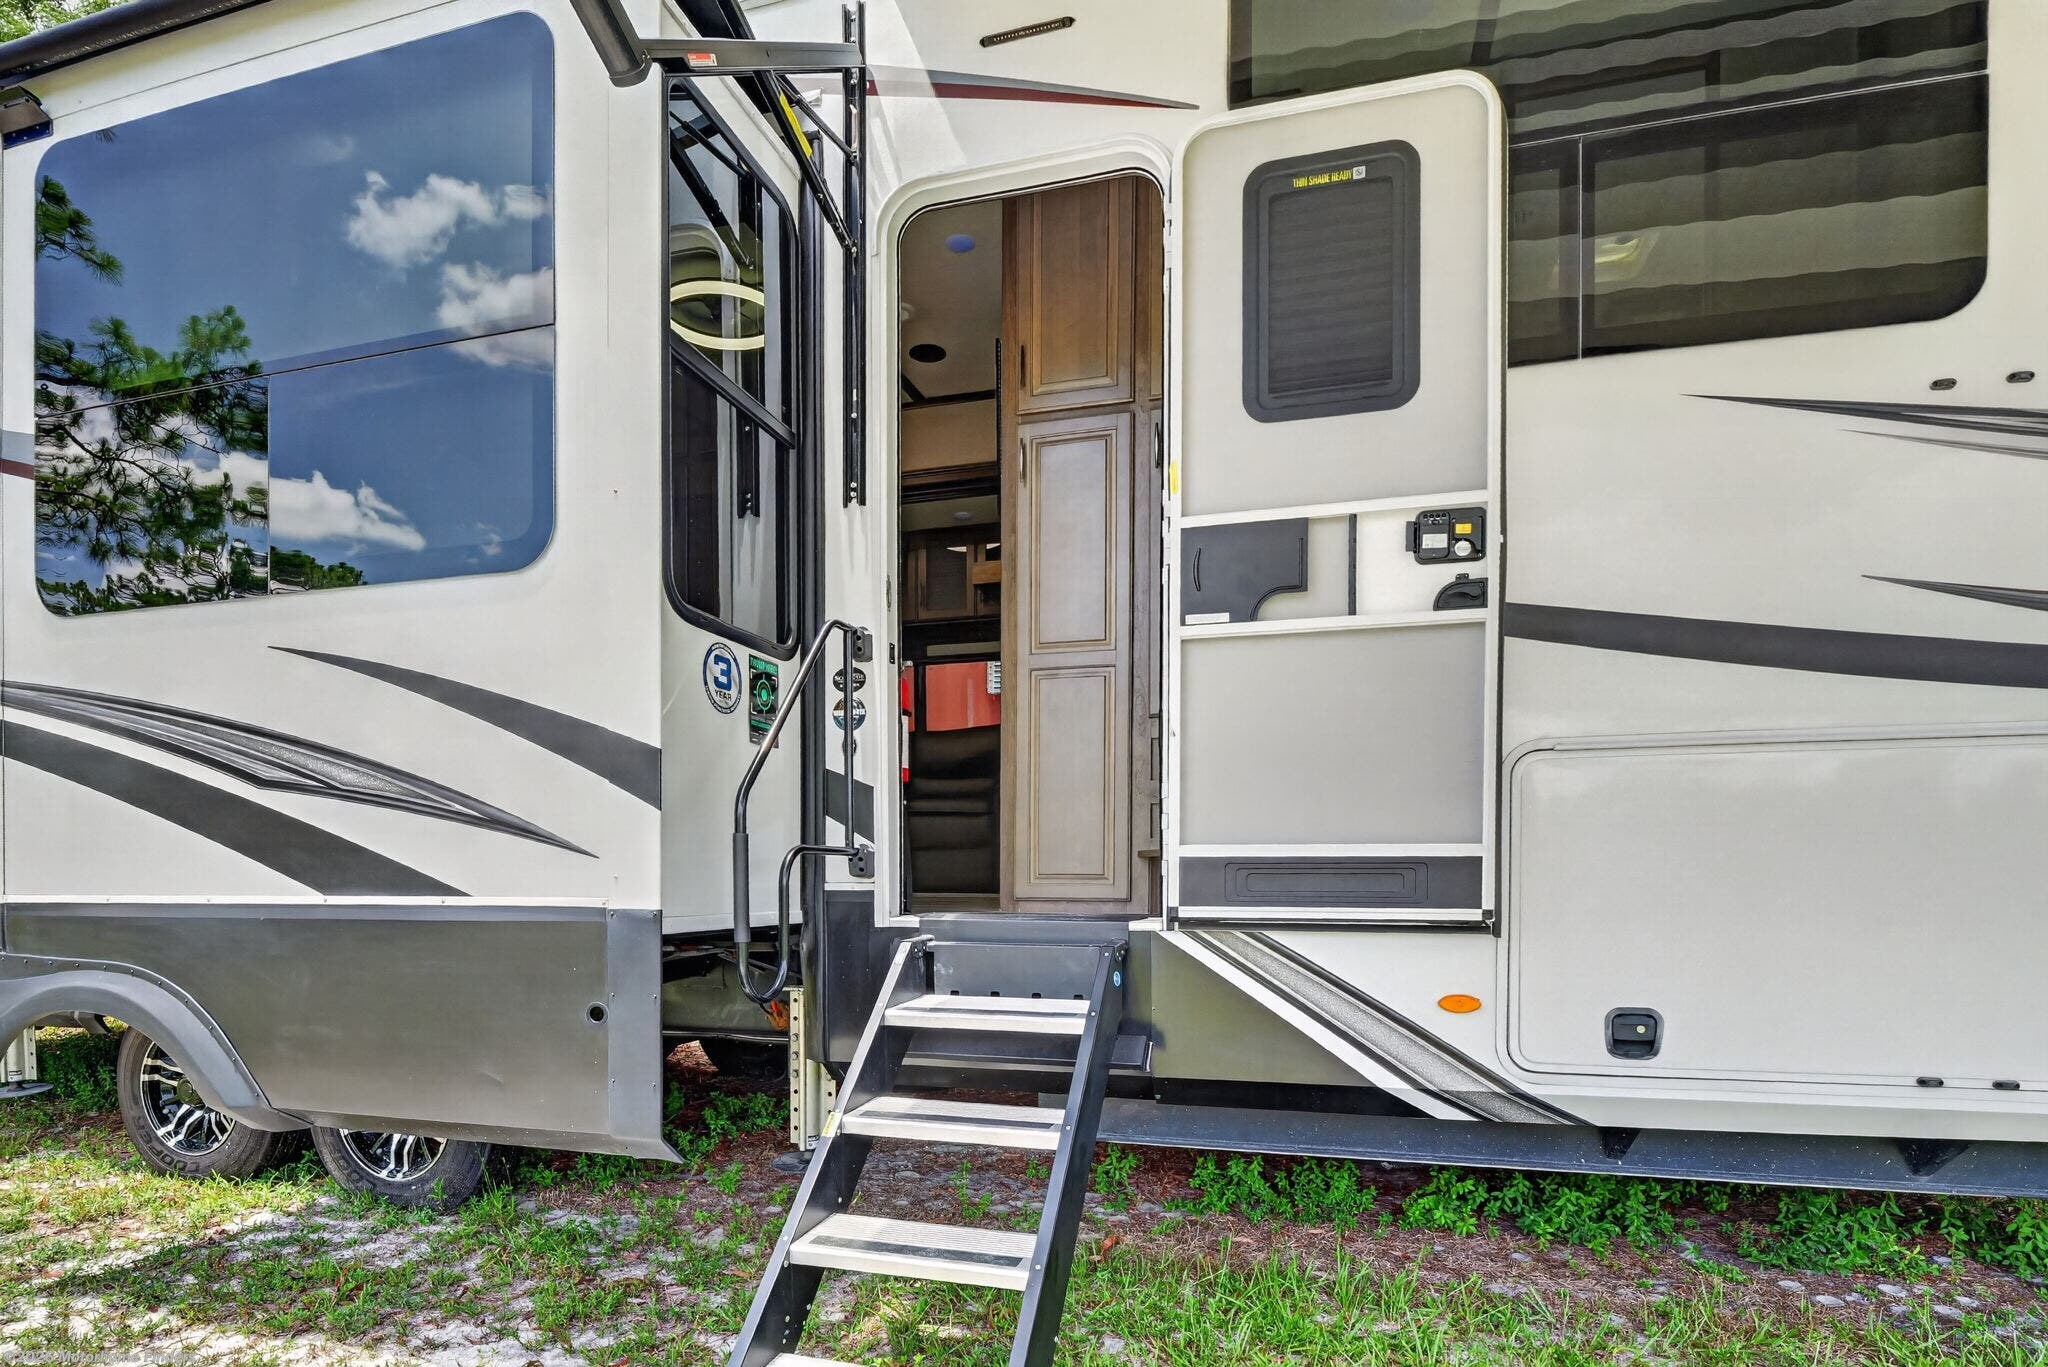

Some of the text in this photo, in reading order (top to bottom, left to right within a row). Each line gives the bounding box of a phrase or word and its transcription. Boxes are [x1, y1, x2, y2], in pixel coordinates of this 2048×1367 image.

[1293, 178, 1307, 187] THIN
[1309, 173, 1330, 185] SHADE
[1331, 169, 1352, 181] READY
[714, 653, 732, 692] 3
[714, 689, 732, 703] YEAR
